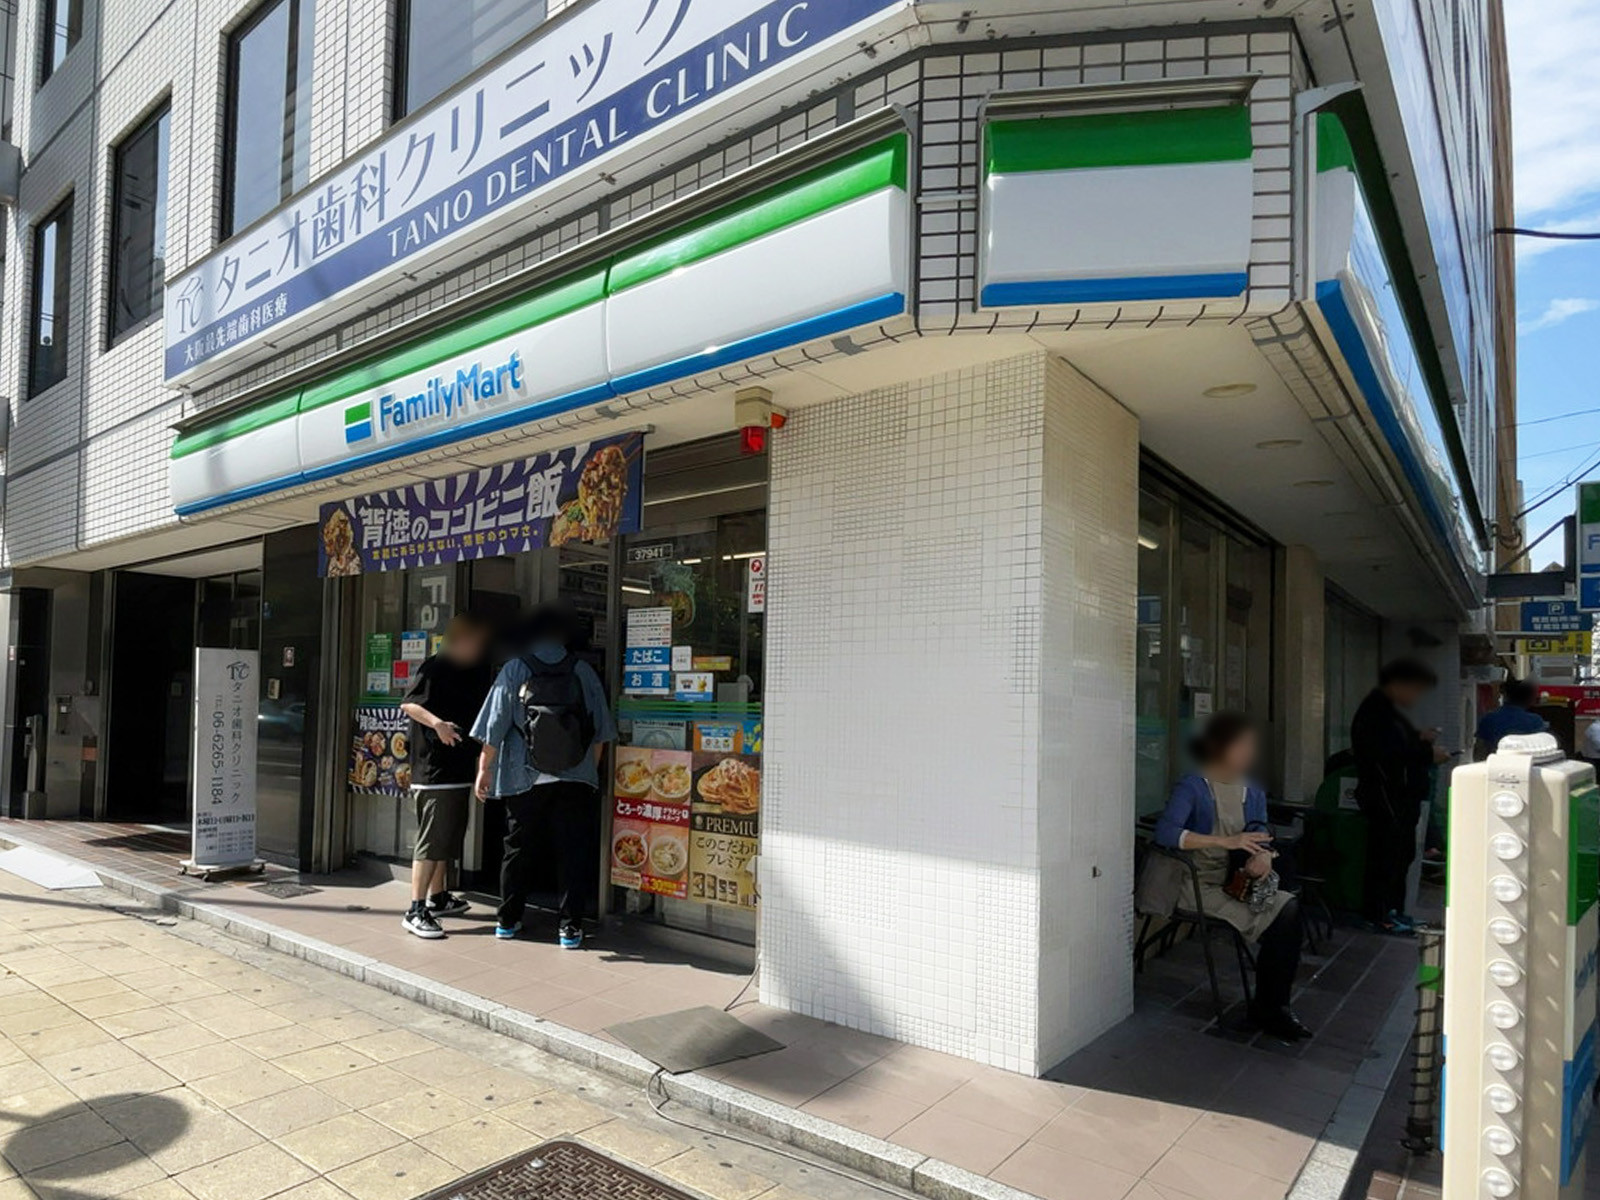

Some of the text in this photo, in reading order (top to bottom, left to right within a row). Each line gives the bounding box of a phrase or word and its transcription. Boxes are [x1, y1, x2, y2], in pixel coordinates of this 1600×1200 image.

[216, 0, 692, 314] タニオ歯科クリニック
[388, 2, 809, 257] TANIO DENTAL CLINIC
[379, 351, 523, 432] FamilyMart
[358, 464, 566, 549] 背徳のコンビニ飯
[635, 547, 664, 560] 37941
[631, 650, 663, 664] たばこ
[211, 711, 224, 805] 06-6265-1184
[231, 681, 243, 804] タニオ歯科クリニック
[696, 836, 758, 855] このこだわり
[706, 853, 746, 869] プレミア
